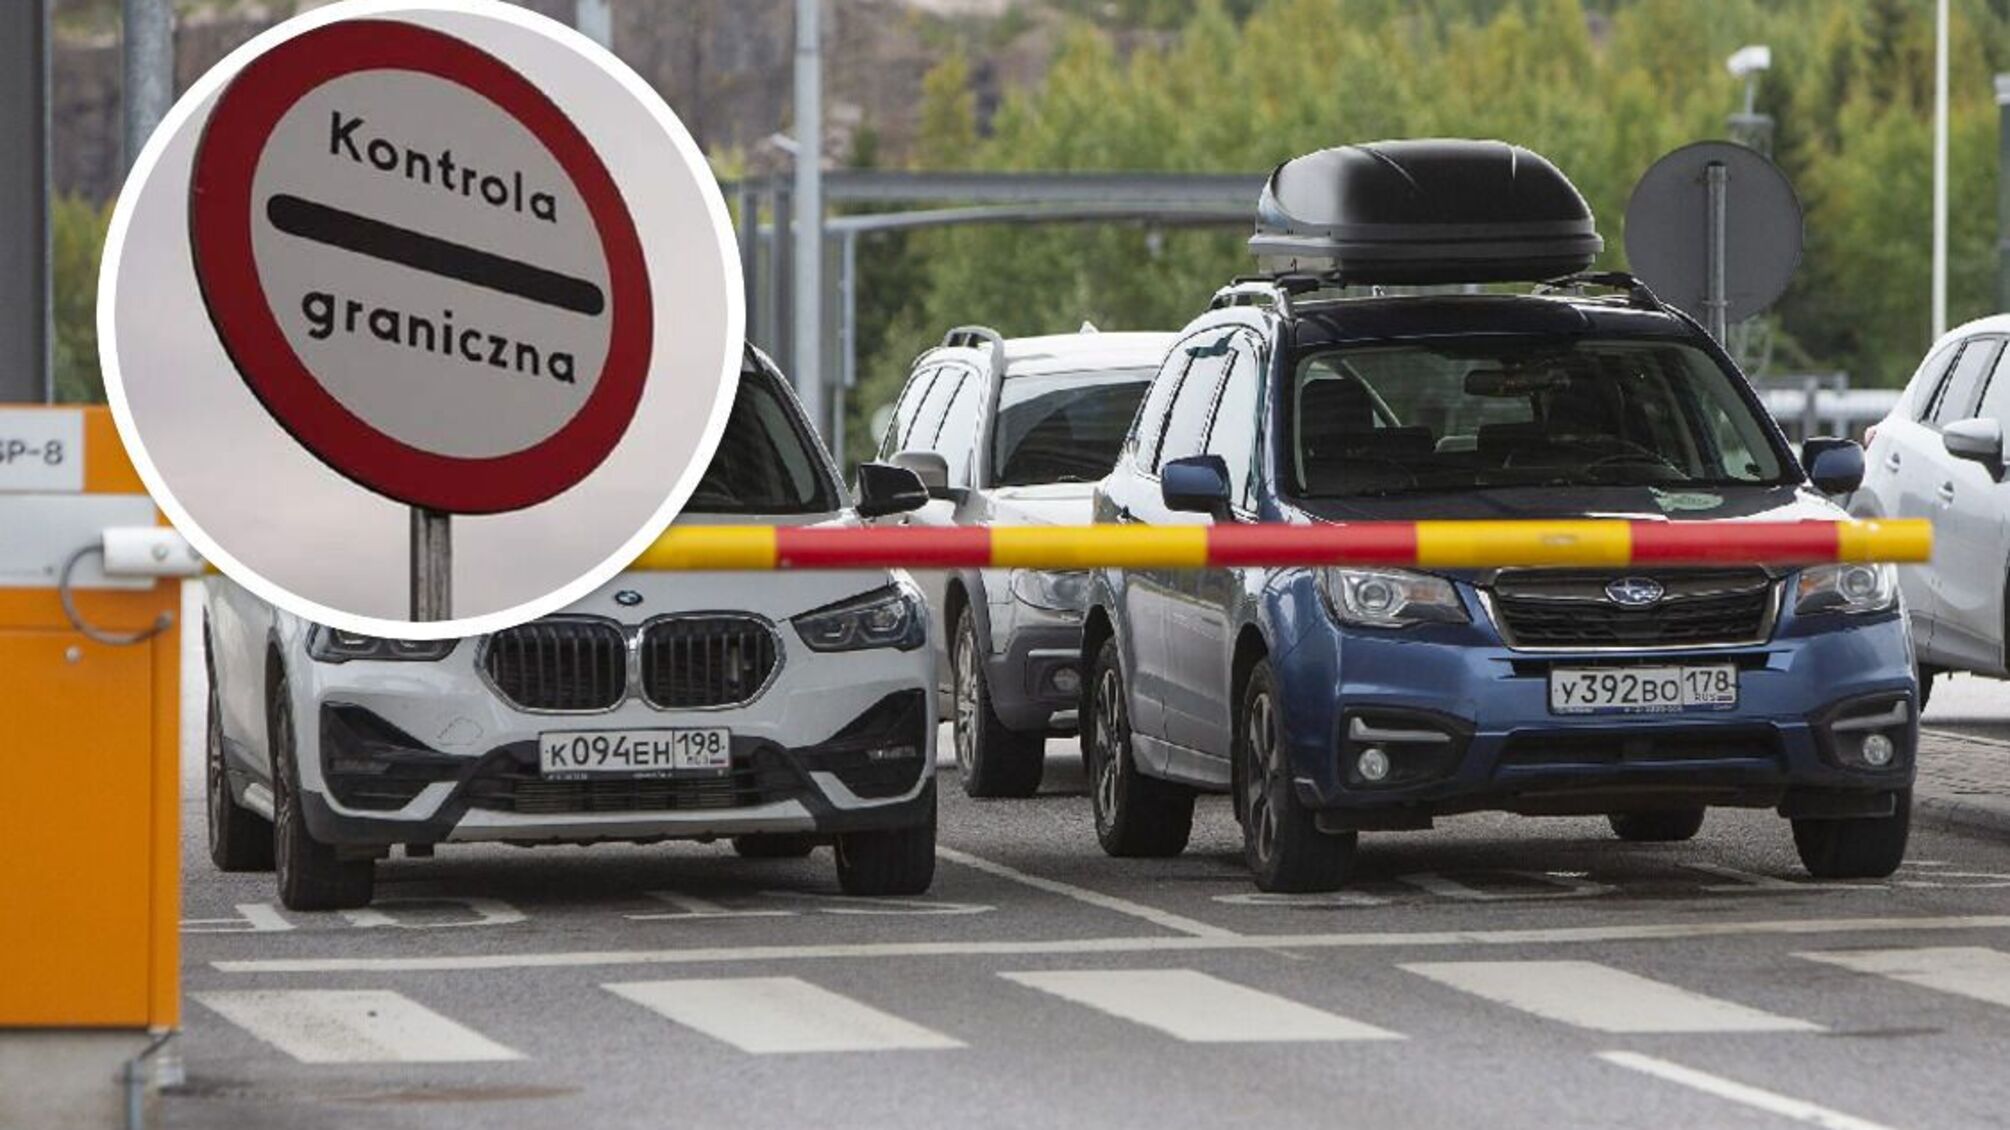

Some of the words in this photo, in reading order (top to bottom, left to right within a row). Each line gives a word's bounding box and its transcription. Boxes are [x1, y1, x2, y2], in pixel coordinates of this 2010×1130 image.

[330, 111, 557, 223] Kontrola
[302, 292, 575, 383] graniczna
[0, 439, 63, 465] P-8
[1685, 670, 1729, 693] 178
[676, 732, 720, 755] 198
